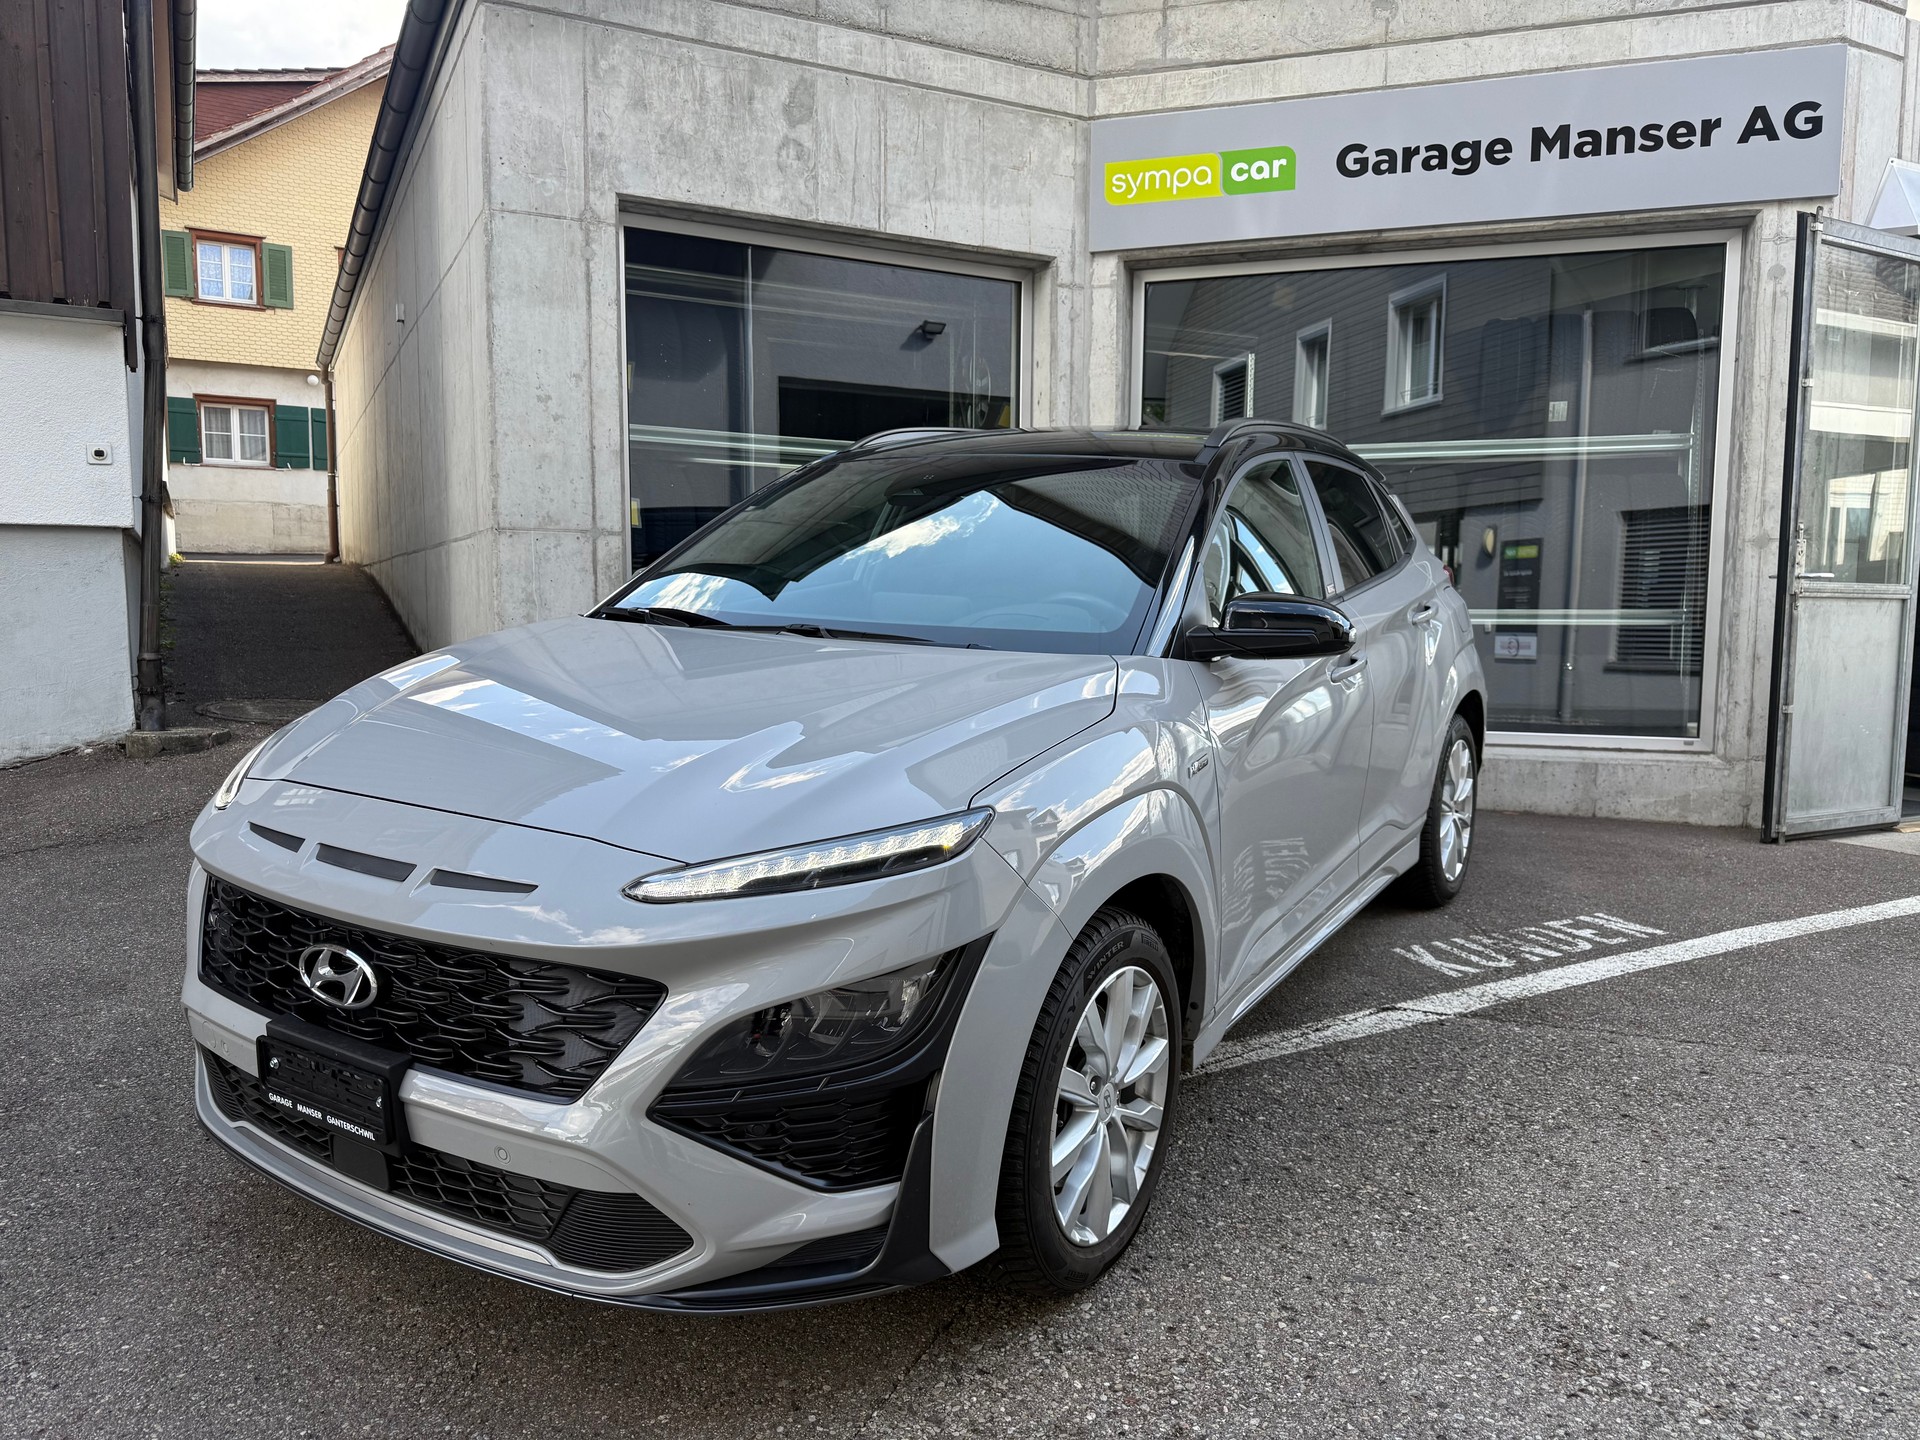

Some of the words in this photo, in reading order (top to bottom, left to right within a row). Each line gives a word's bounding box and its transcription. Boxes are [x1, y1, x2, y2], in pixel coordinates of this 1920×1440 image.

[1336, 136, 1513, 178] Garage
[1530, 117, 1722, 162] Manser
[1736, 101, 1824, 144] AG
[1111, 165, 1212, 199] sympa
[1230, 158, 1287, 182] car
[1086, 940, 1124, 979] WINTER
[1392, 912, 1669, 977] KUNDEN
[268, 1092, 293, 1108] GARAGE
[297, 1103, 323, 1120] MANSER
[326, 1115, 376, 1141] GANTERSCHWIL
